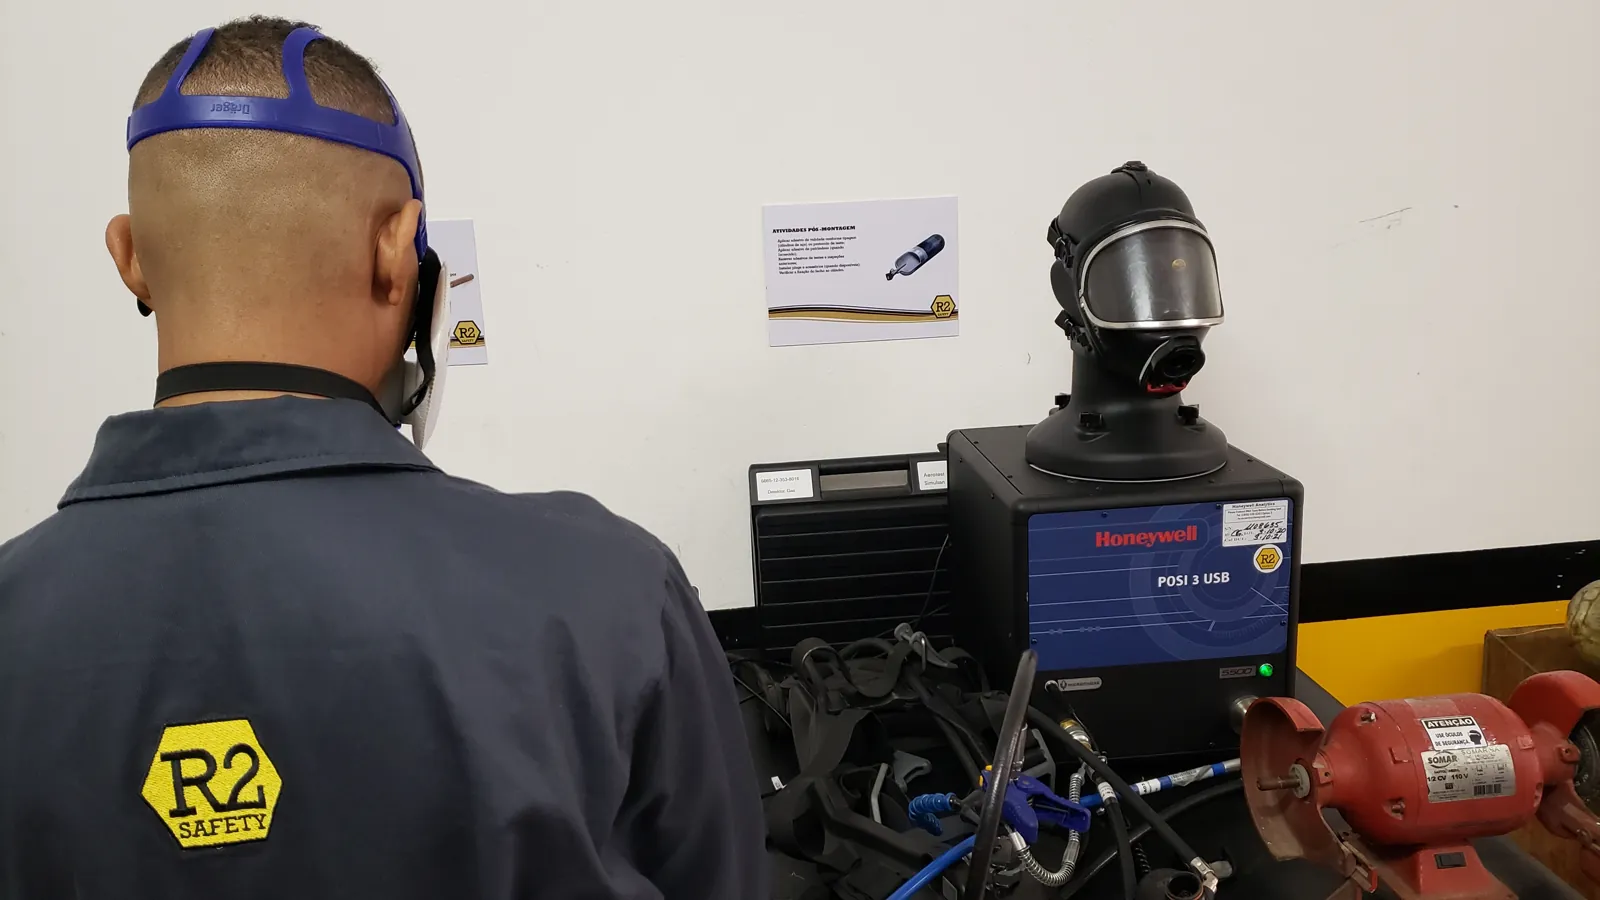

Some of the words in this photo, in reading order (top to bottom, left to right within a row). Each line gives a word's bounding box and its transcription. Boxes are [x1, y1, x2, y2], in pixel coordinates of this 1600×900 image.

[210, 102, 250, 114] Dräger
[936, 301, 950, 312] R2
[459, 327, 475, 338] R2
[1096, 526, 1197, 547] Honeywell
[1261, 554, 1275, 564] R2
[1158, 574, 1188, 587] POSI
[1192, 575, 1199, 585] 3
[1204, 572, 1230, 584] USB
[1428, 718, 1472, 727] ATENÇÃO
[1428, 755, 1458, 764] SOMAR
[160, 743, 266, 818] R2
[179, 814, 266, 838] SAFETY
